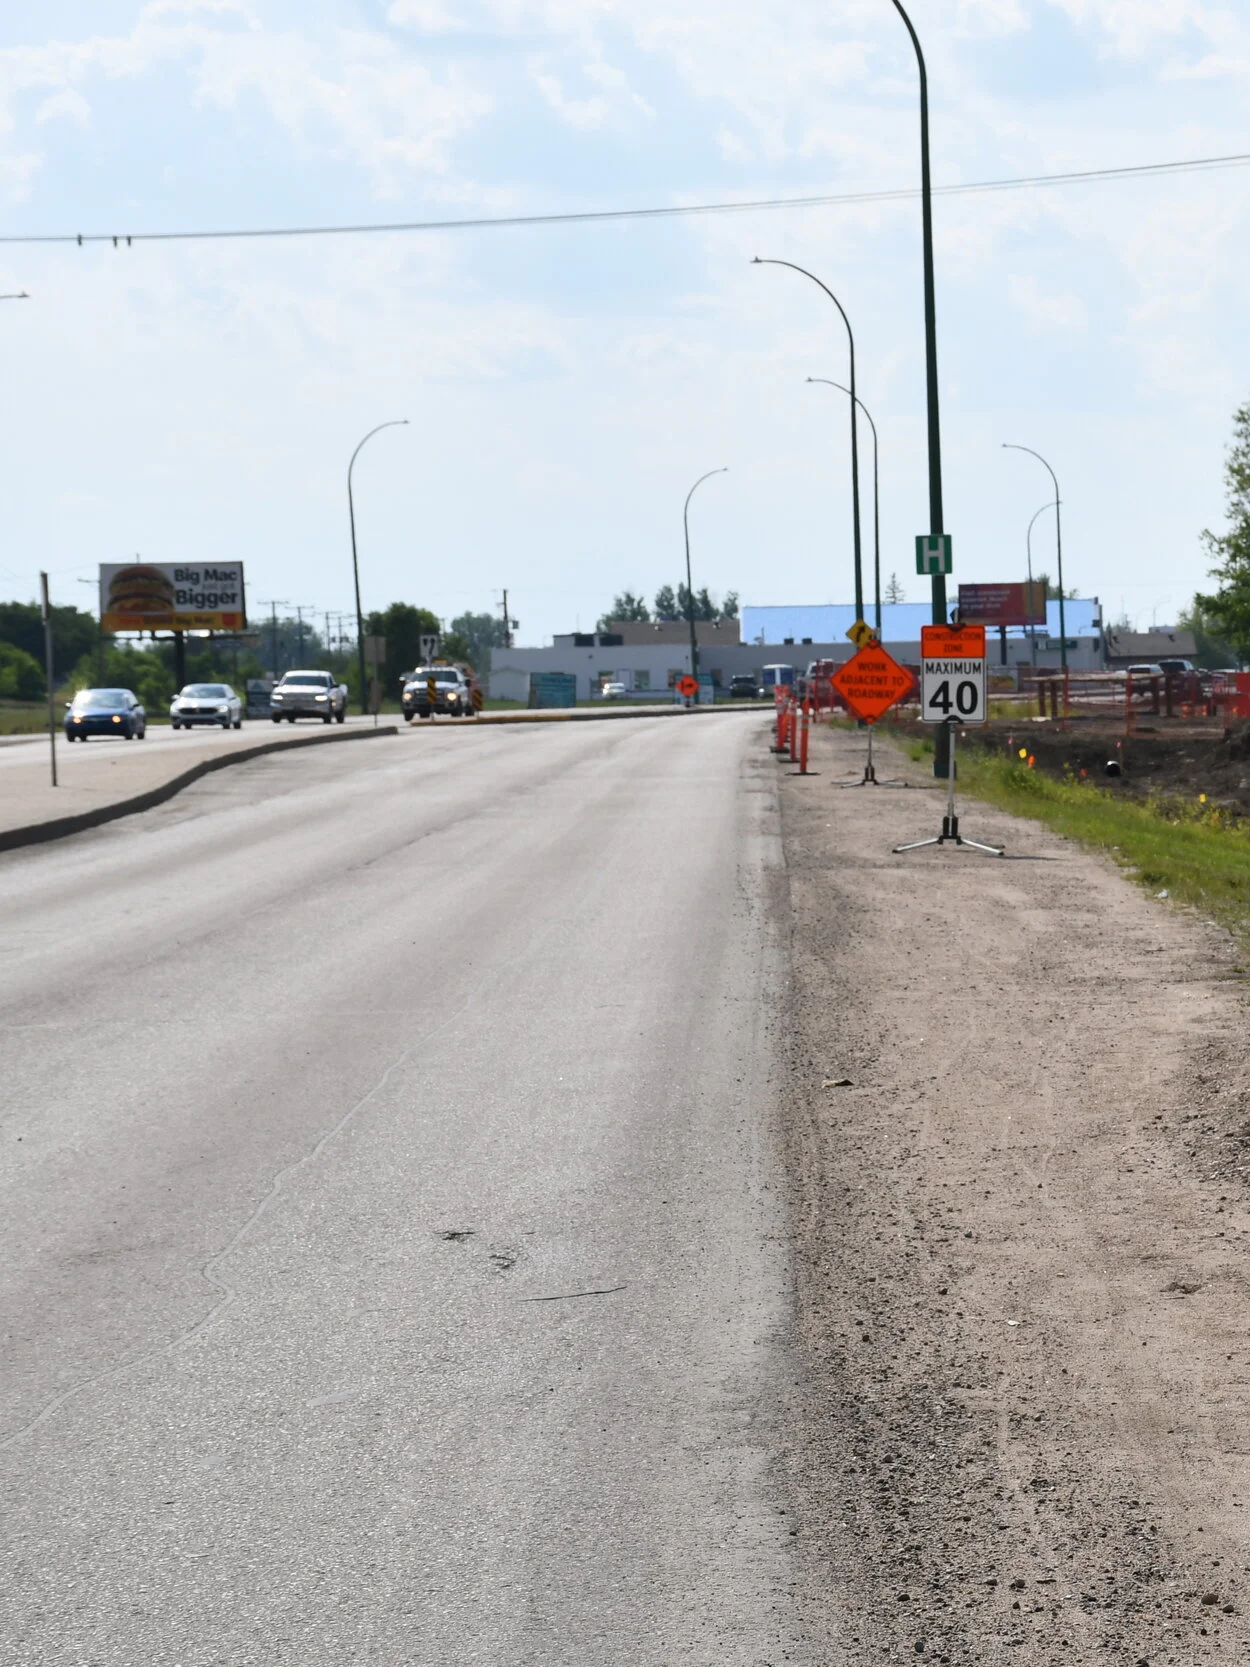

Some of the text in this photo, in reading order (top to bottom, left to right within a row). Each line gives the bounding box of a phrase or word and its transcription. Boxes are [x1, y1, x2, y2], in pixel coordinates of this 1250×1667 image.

[922, 537, 946, 573] H
[174, 568, 238, 585] Big Mac
[175, 588, 238, 609] Bigger
[943, 643, 964, 653] ZONE
[857, 662, 888, 672] WORK
[925, 662, 982, 675] MAXIMUM
[840, 675, 905, 687] ADJACENT TO
[847, 688, 896, 698] ROADWAY
[929, 680, 978, 715] 40
